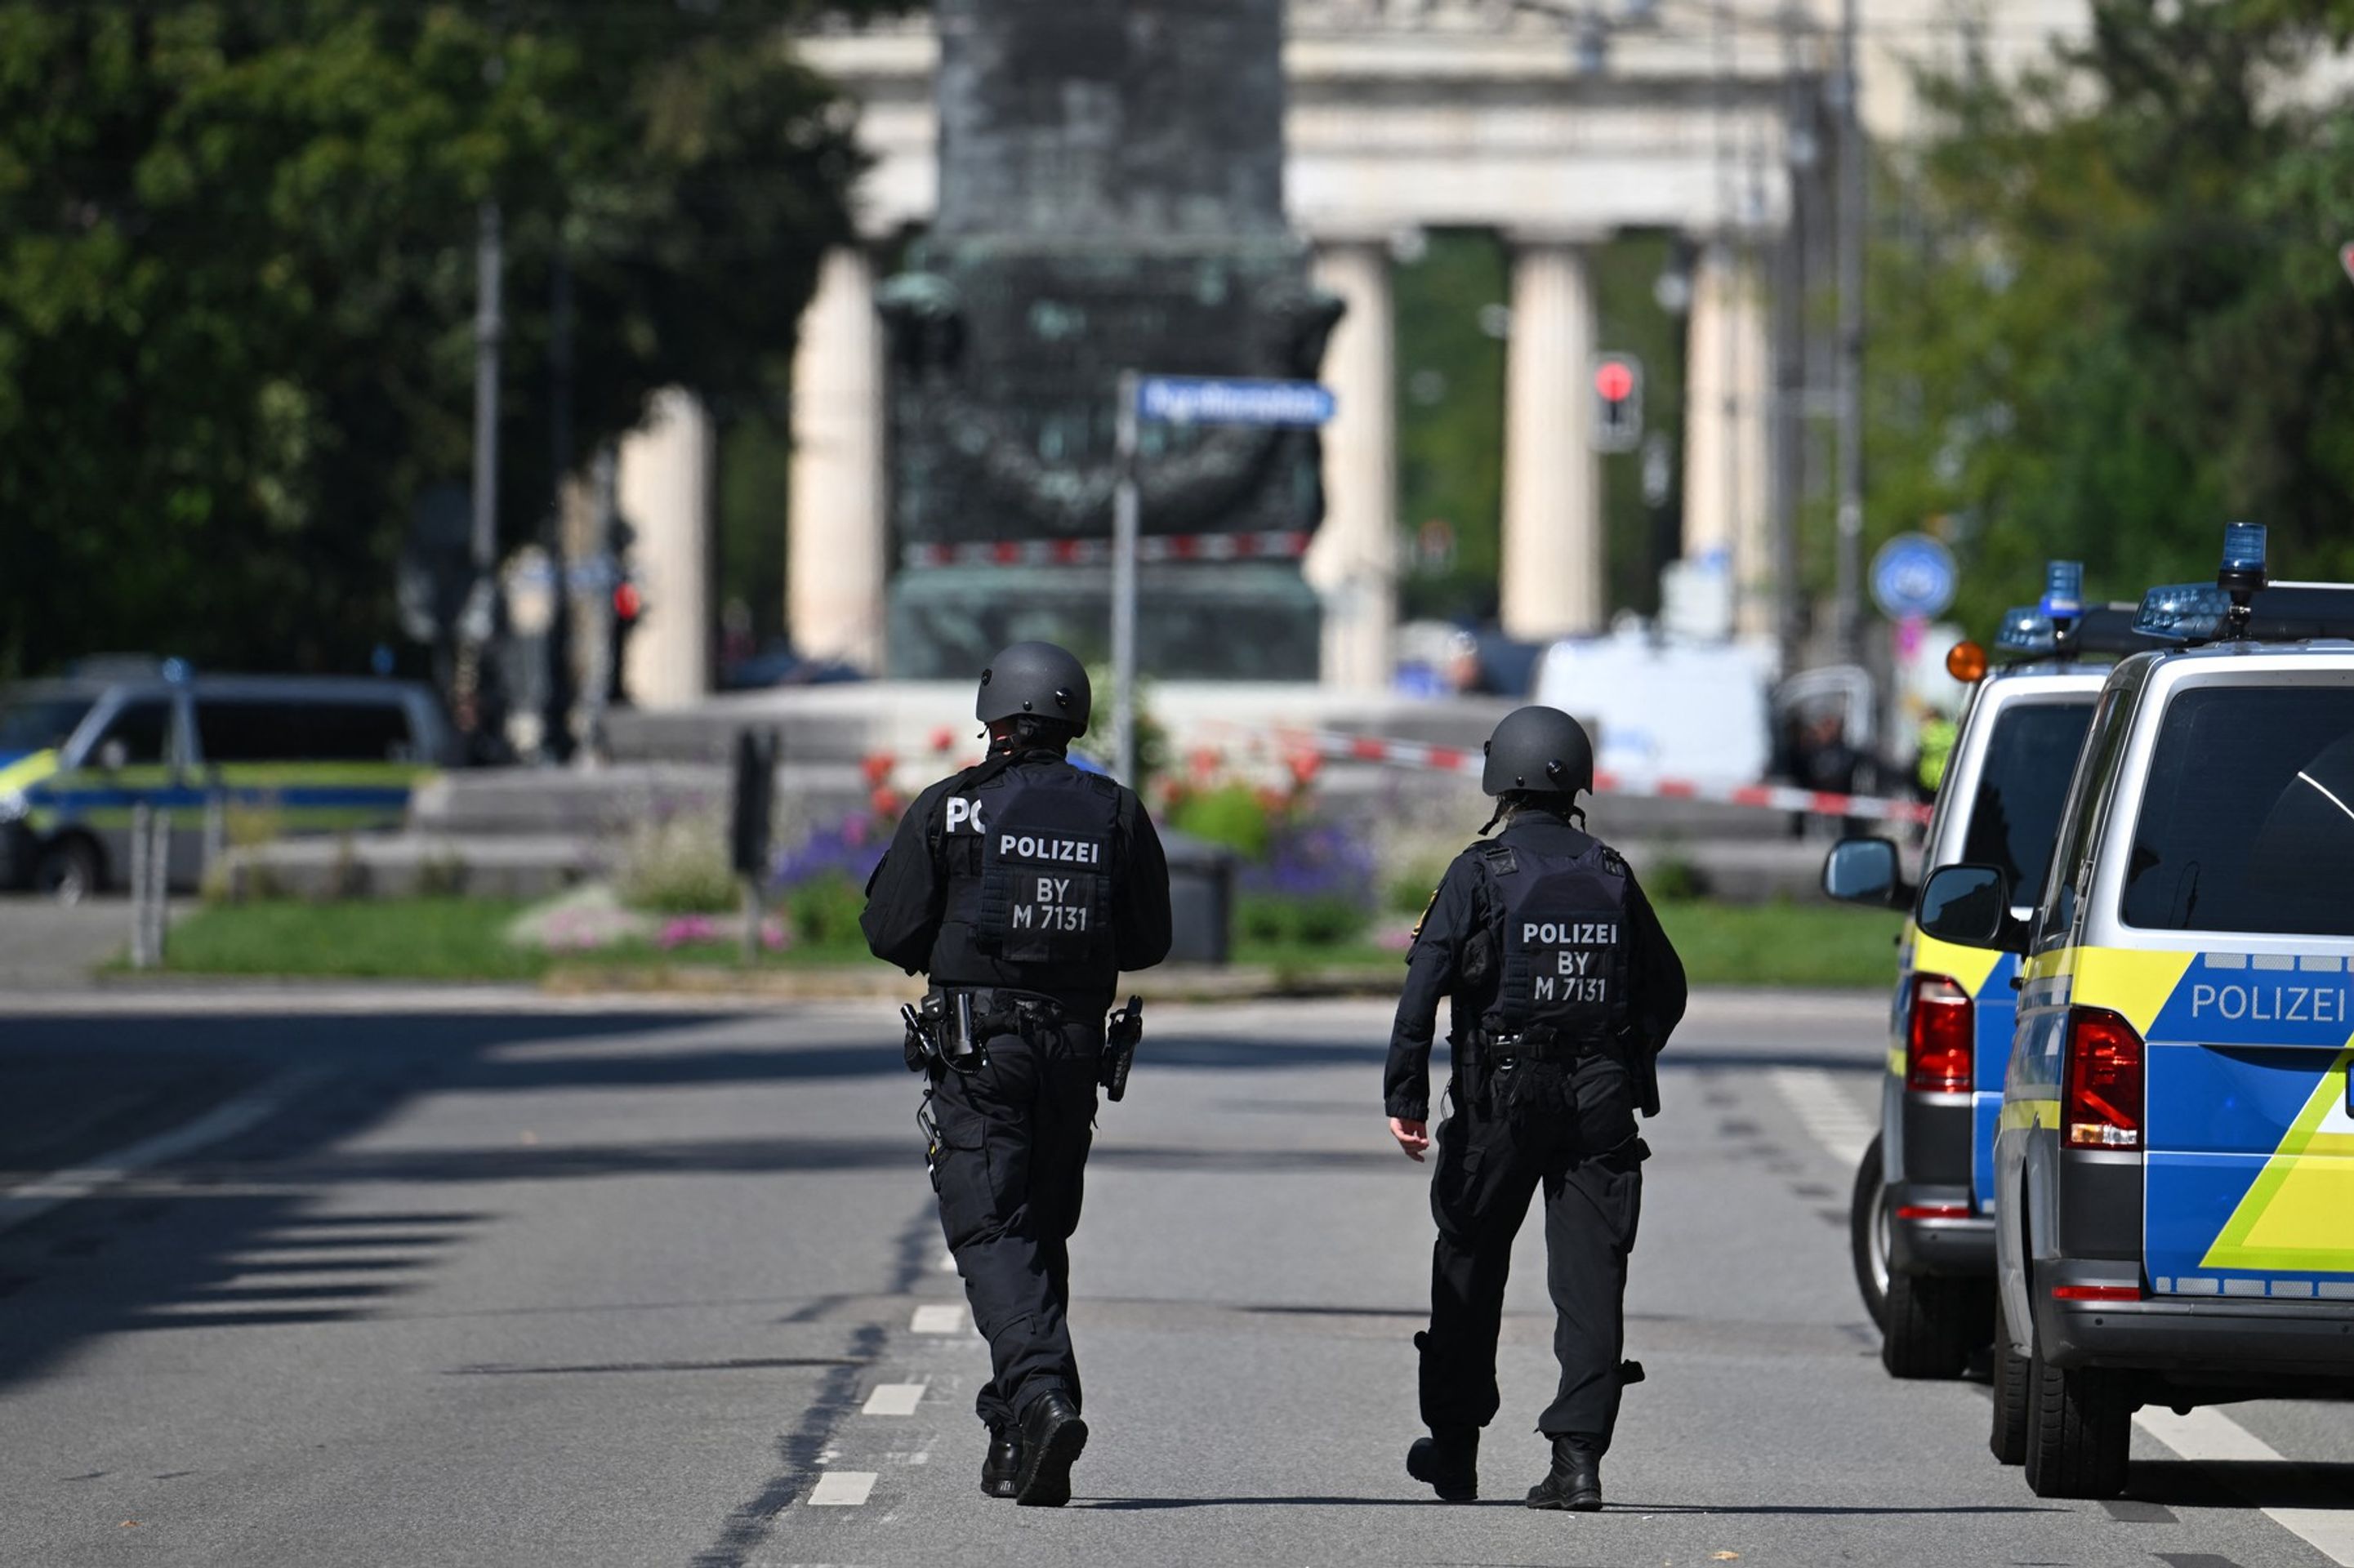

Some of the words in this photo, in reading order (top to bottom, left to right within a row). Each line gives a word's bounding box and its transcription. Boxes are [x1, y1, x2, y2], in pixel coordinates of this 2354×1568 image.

[1000, 835, 1099, 863] POLIZEI
[1037, 878, 1070, 903] BY
[1012, 905, 1032, 929] M
[1041, 906, 1086, 931] 7131
[1523, 923, 1617, 944] POLIZEI
[1558, 951, 1589, 975] BY
[1534, 976, 1554, 1000] M
[1562, 978, 1606, 1002] 7131
[2191, 984, 2346, 1022] POLIZEI
